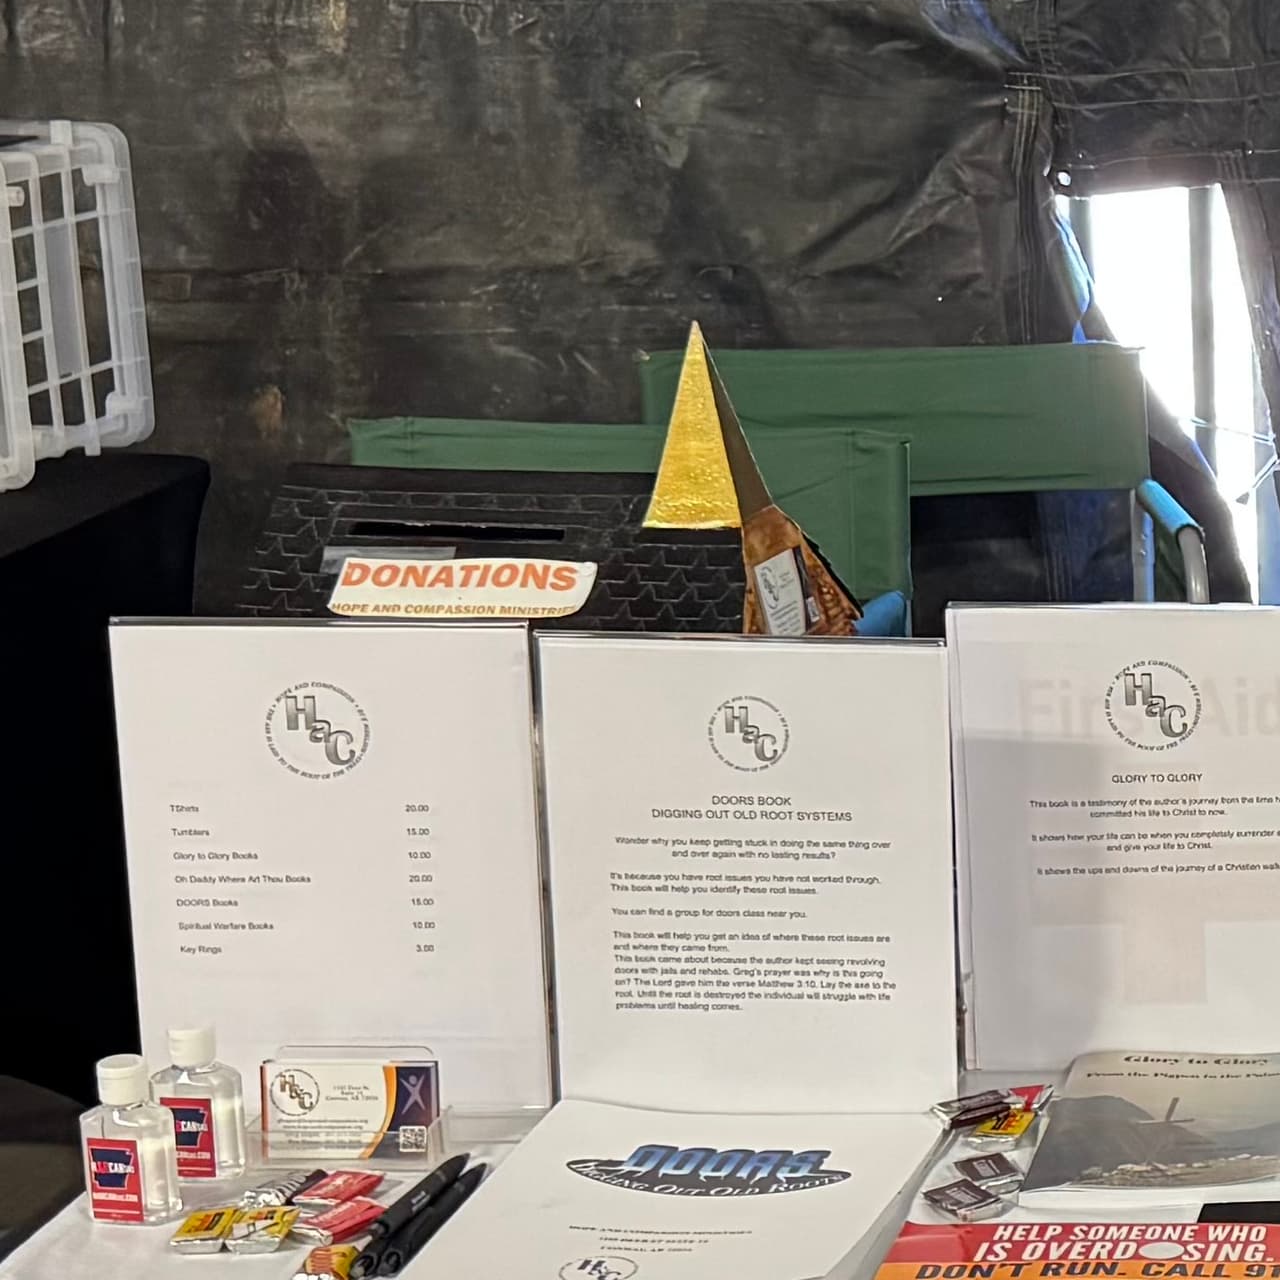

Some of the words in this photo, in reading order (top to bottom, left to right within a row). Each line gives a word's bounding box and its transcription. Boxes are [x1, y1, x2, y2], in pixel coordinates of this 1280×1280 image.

[341, 562, 579, 591] DONATIONS
[331, 602, 369, 614] HOPE
[372, 603, 401, 614] AND
[403, 604, 496, 616] COMPASSION
[1110, 773, 1148, 785] GLORY
[1149, 772, 1165, 784] TO
[1165, 772, 1203, 784] GLORY
[710, 794, 754, 807] DOORS
[756, 795, 791, 807] BOOK
[650, 808, 703, 820] DIGGING
[704, 808, 729, 821] OUT
[731, 809, 757, 821] OLD
[758, 809, 793, 822] ROOT
[795, 810, 852, 823] SYSTEMS
[992, 1224, 1066, 1241] HELP
[1067, 1224, 1200, 1242] SOMEONE
[1206, 1224, 1269, 1242] WHO
[974, 1241, 1010, 1262] IS
[1038, 1261, 1129, 1278] RUN.
[1140, 1262, 1233, 1280] CALL
